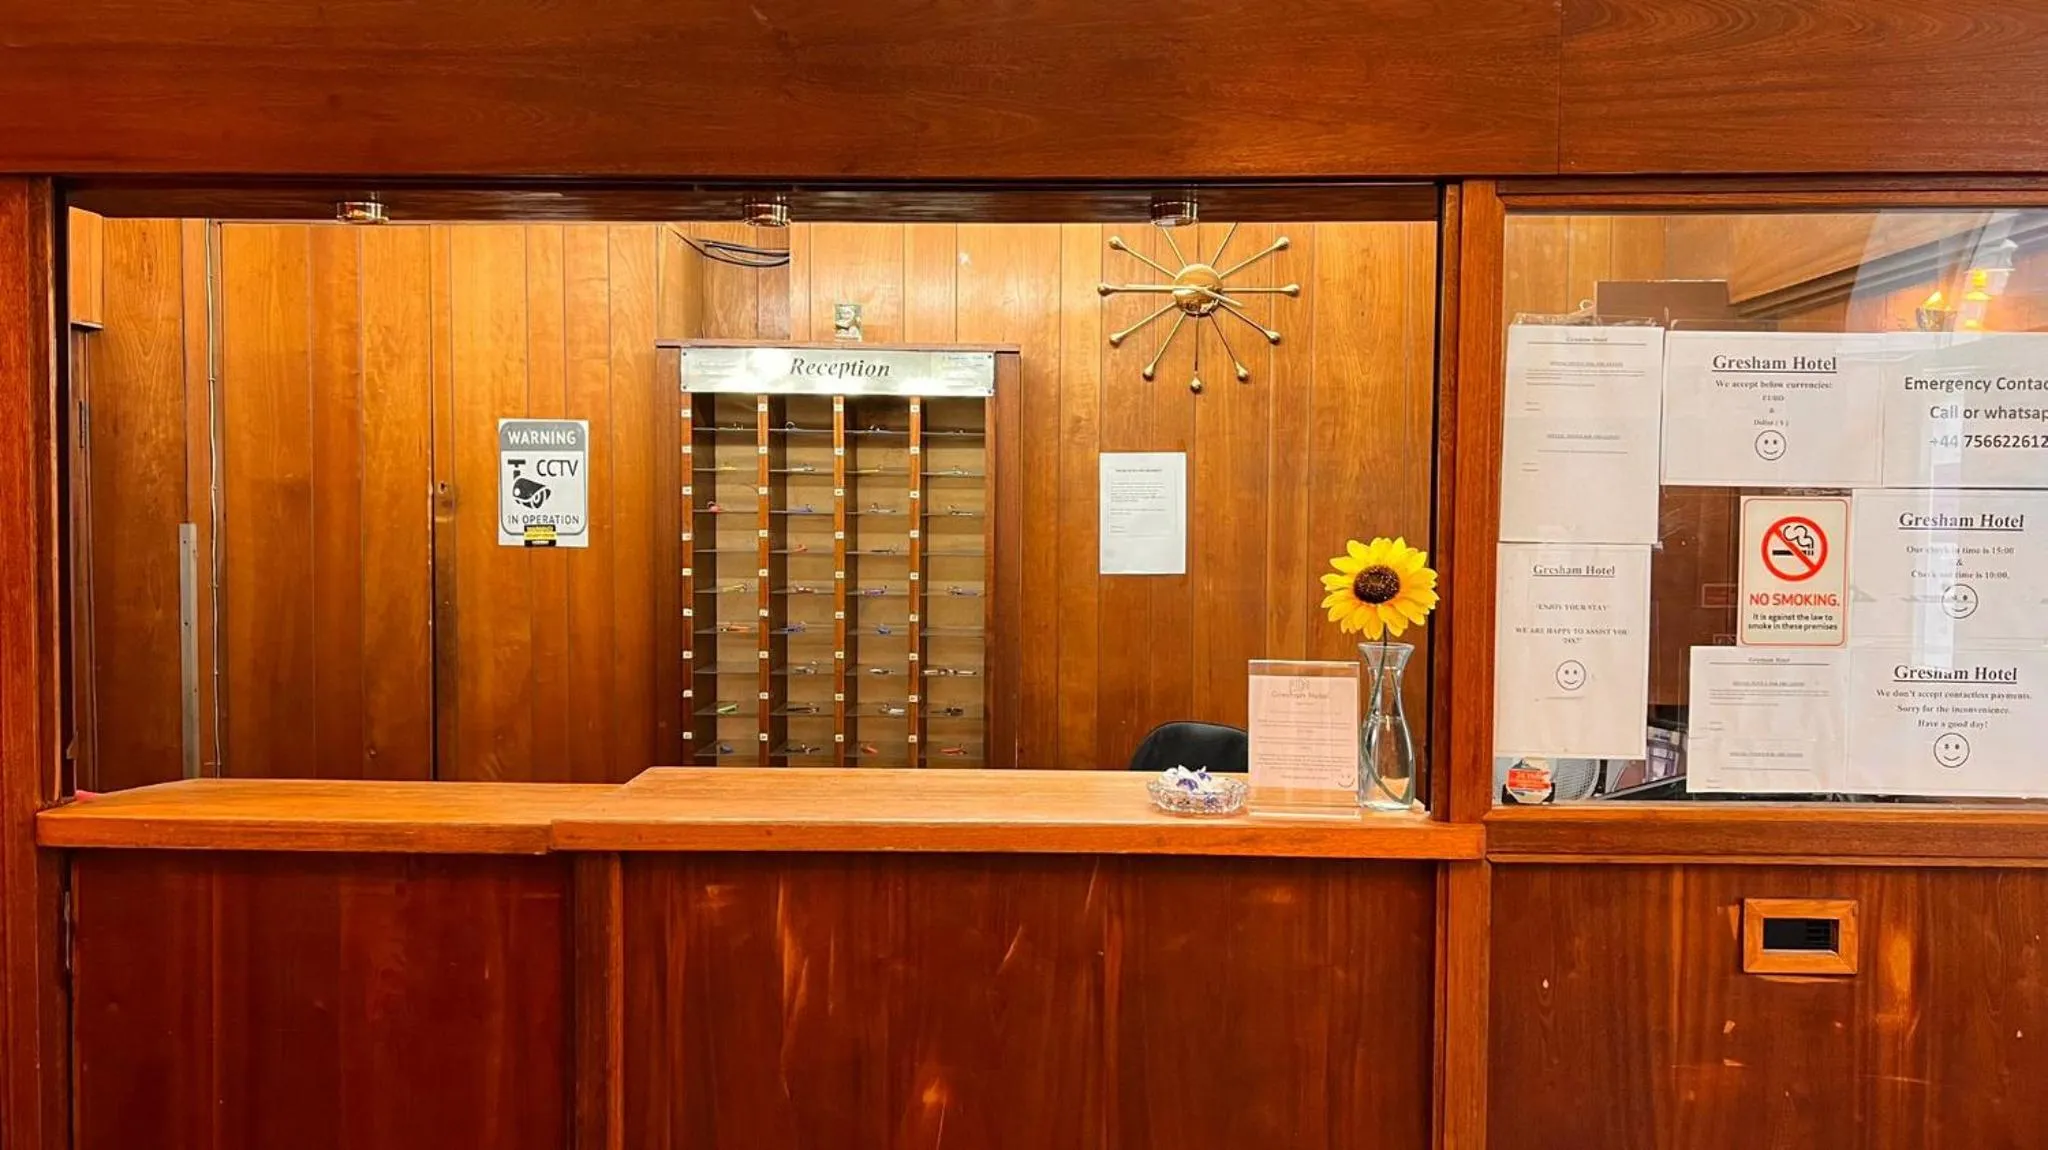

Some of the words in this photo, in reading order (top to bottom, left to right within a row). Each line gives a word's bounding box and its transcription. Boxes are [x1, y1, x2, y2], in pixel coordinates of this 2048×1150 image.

[790, 358, 890, 379] Reception
[1712, 355, 1787, 370] Gresham
[1793, 356, 1837, 371] Hotel
[1715, 380, 1730, 388] We
[1731, 381, 1759, 390] accept
[1760, 380, 1784, 389] below
[1904, 376, 1992, 393] Emergency
[1930, 405, 1959, 419] Call
[1963, 408, 1980, 419] or
[507, 431, 577, 445] WARNING
[1929, 434, 1959, 448] +44
[536, 459, 579, 477] CCTV
[508, 514, 519, 525] IN
[522, 514, 580, 525] OPERATION
[1899, 512, 1974, 527] Gresham
[1980, 513, 2025, 528] Hotel
[1533, 564, 1582, 575] Gresham
[1586, 565, 1615, 575] Hotel
[1749, 593, 1769, 606] NO
[1772, 593, 1840, 607] SMOKING.
[1753, 613, 1759, 621] It
[1760, 613, 1767, 621] is
[1768, 613, 1796, 623] against
[1796, 613, 1810, 621] the
[1810, 613, 1823, 621] law
[1748, 622, 1772, 630] smoke
[1773, 622, 1780, 630] in
[1804, 623, 1838, 631] premises
[1894, 664, 1969, 680] Gresham
[1975, 666, 2018, 681] Hotel
[1876, 689, 1891, 698] We
[1918, 690, 1943, 699] accept
[1944, 690, 1989, 699] contactless
[1897, 704, 1921, 713] Sorry
[1922, 704, 1934, 713] for
[1936, 705, 1949, 713] the
[1918, 719, 1939, 727] Have
[1947, 720, 1968, 729] good
